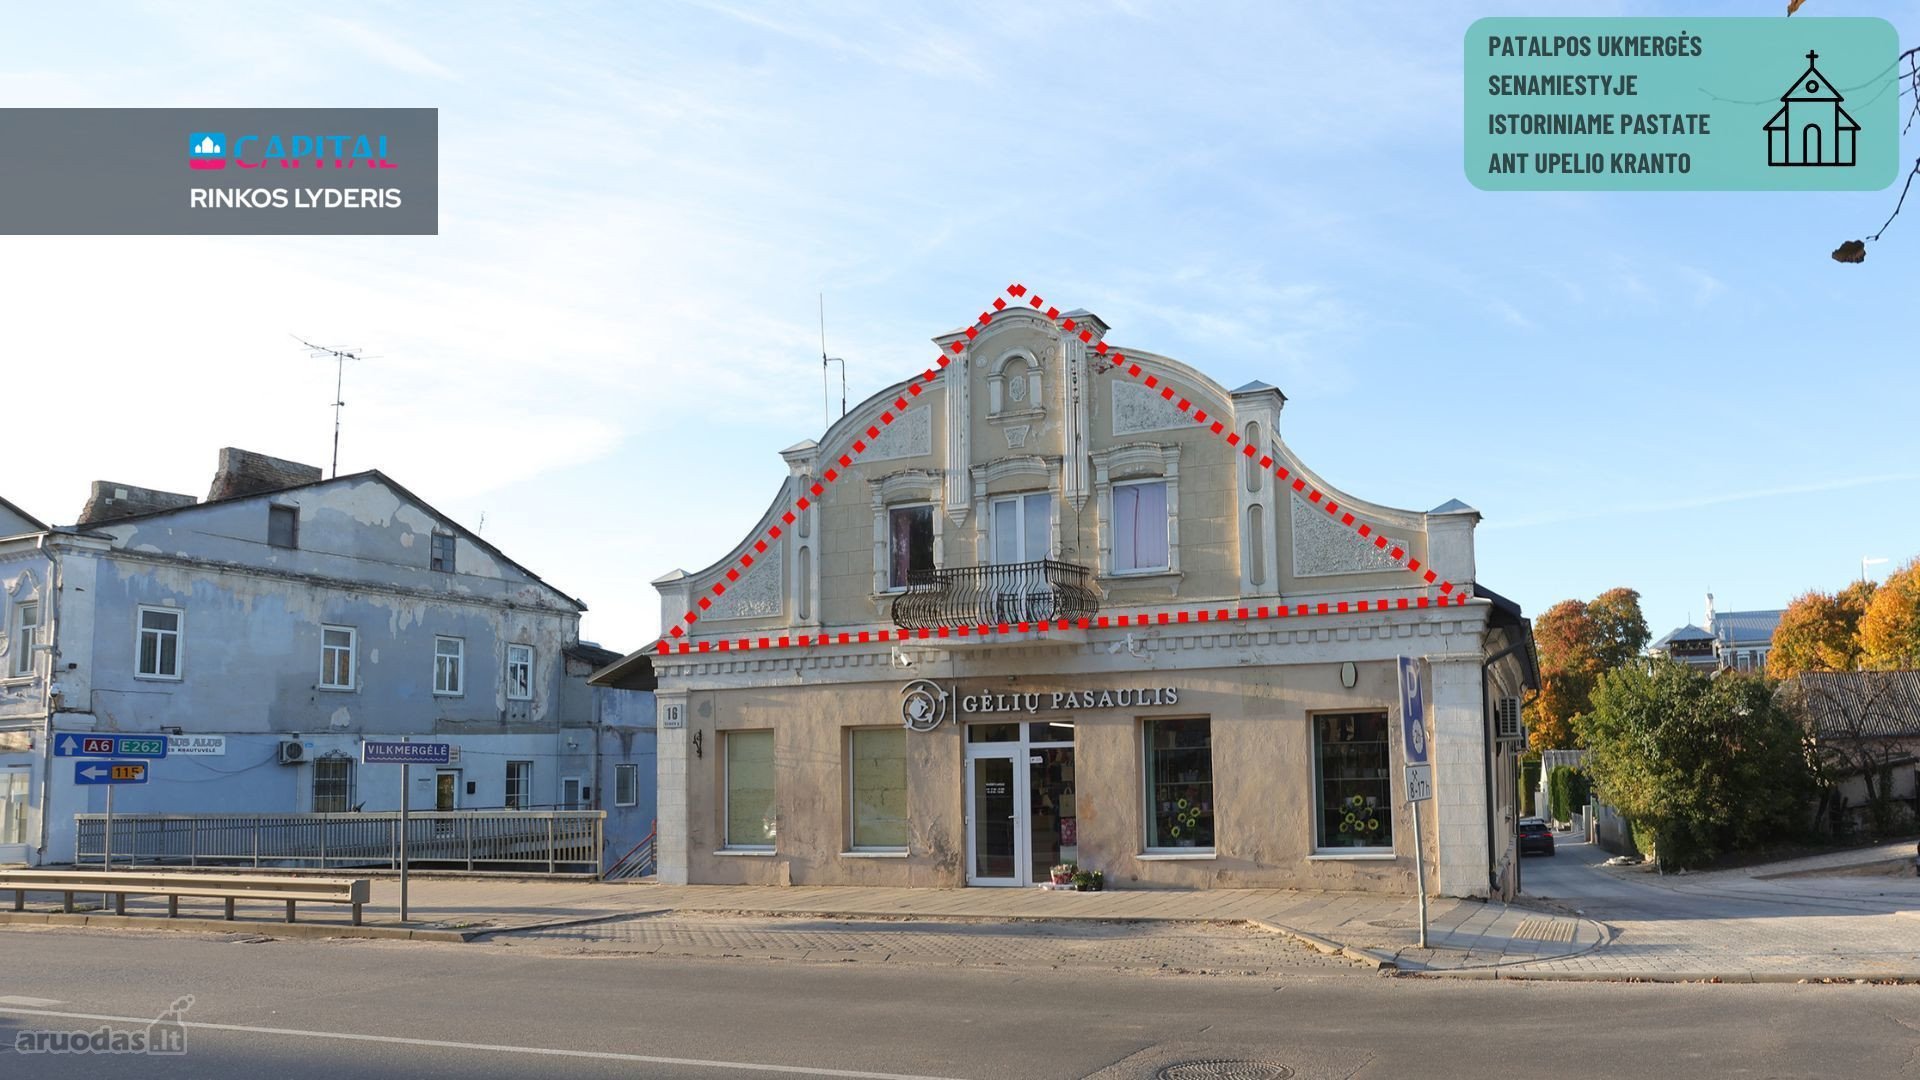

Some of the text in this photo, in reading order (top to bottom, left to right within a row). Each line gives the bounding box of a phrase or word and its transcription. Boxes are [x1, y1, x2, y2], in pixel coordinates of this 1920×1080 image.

[1406, 664, 1418, 716] P
[962, 687, 1178, 714] GĖLIŲ PASAULIS
[667, 706, 678, 720] 16
[88, 740, 160, 753] A6 E262
[367, 744, 448, 756] VILKMERGĖLĖ
[115, 767, 140, 778] 115
